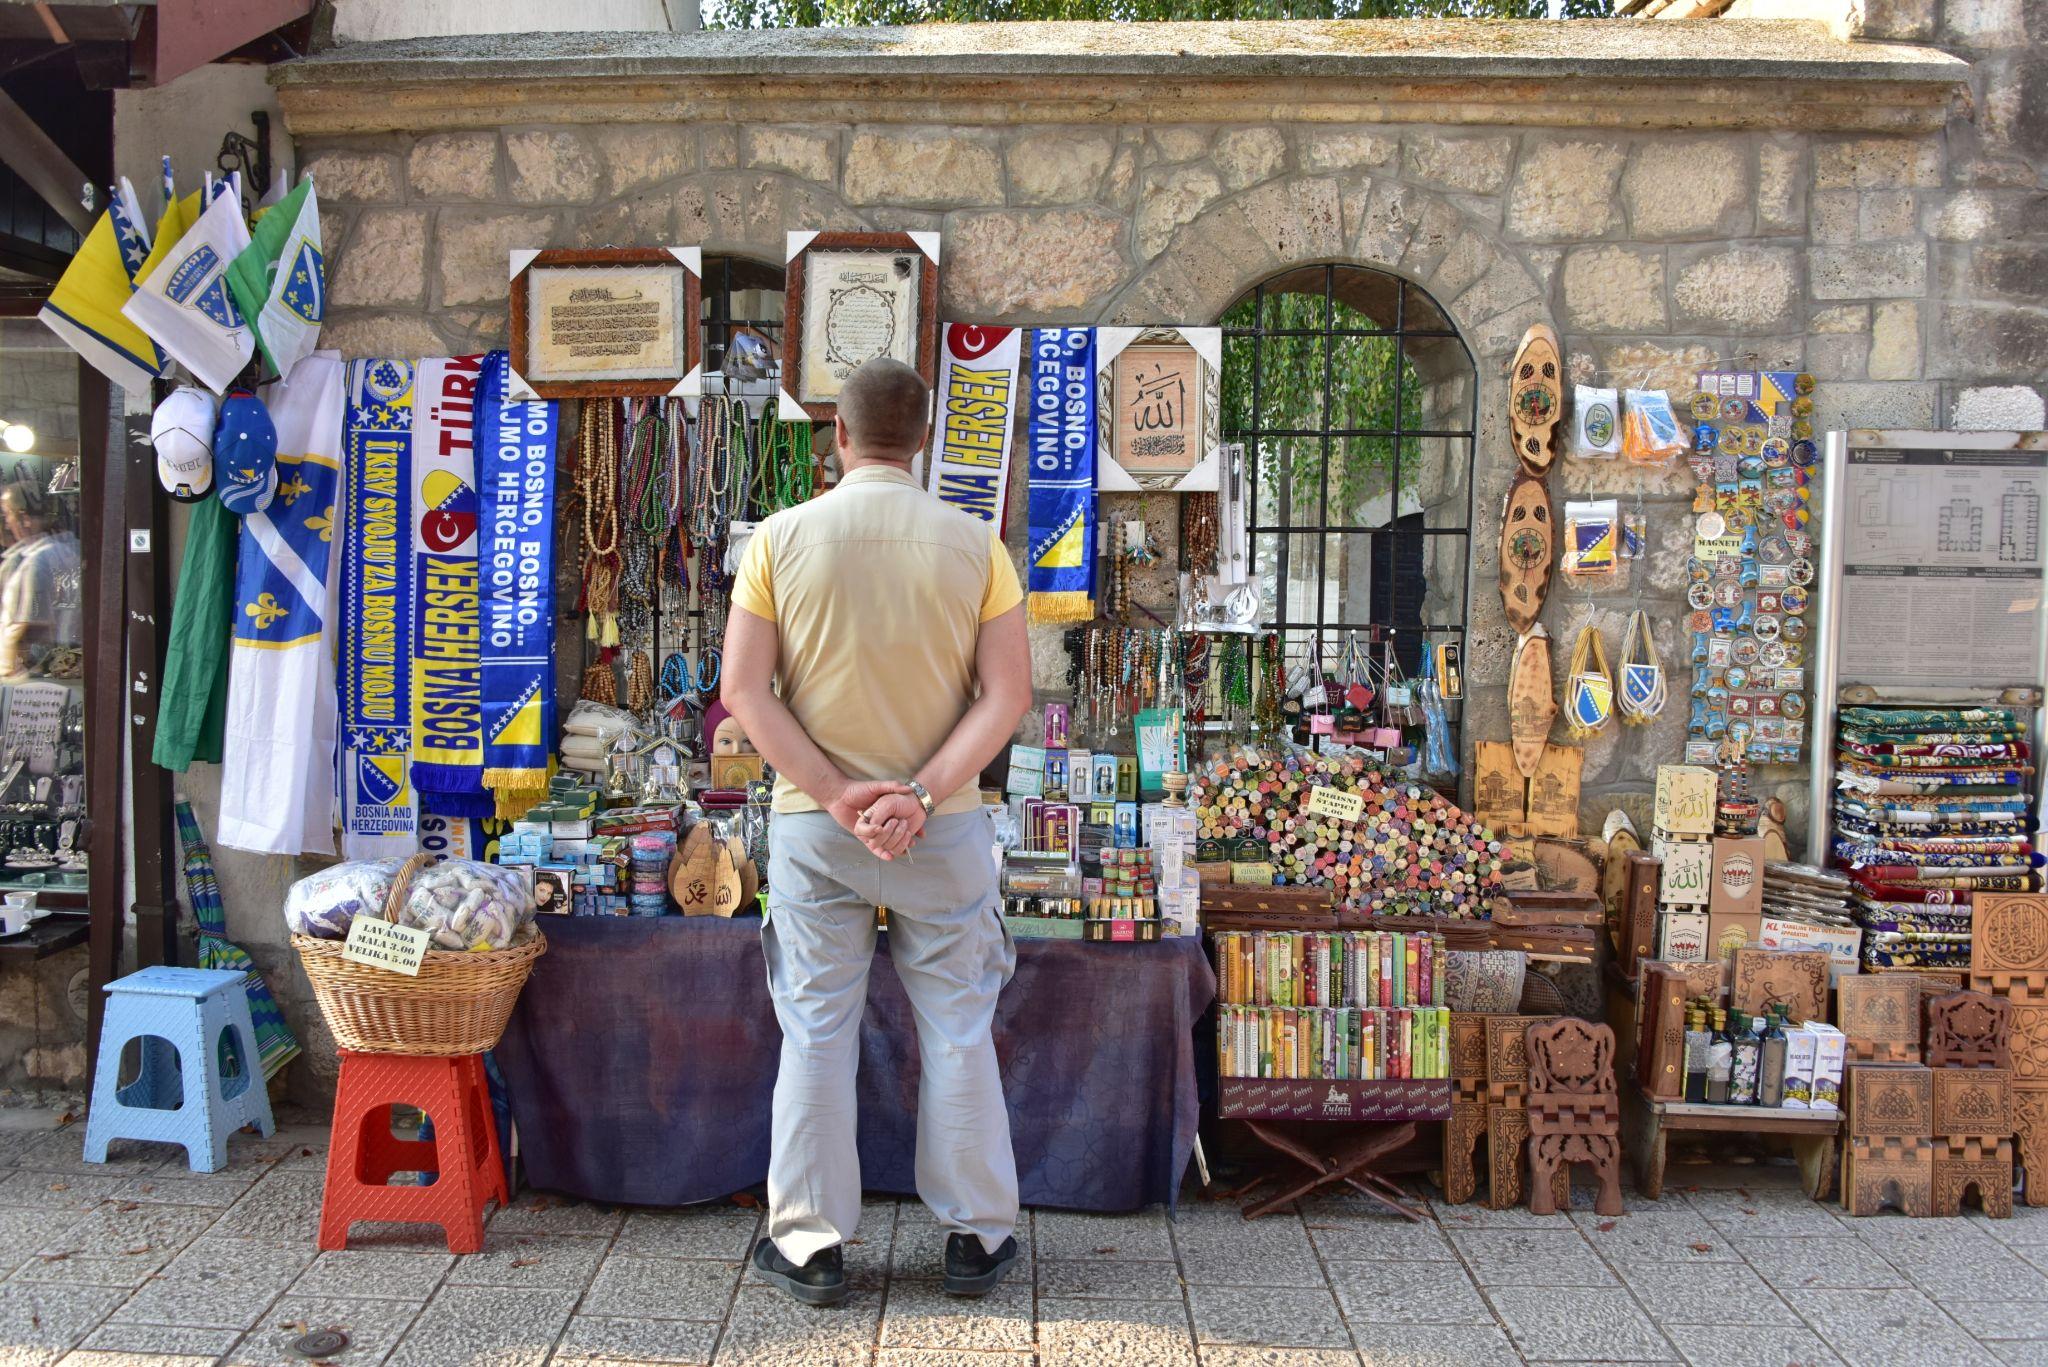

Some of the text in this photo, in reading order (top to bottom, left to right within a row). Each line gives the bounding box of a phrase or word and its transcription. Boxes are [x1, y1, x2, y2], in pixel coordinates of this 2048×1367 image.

[942, 364, 1011, 469] HERSEK
[1065, 365, 1086, 470] BOSNO...
[363, 453, 398, 498] KRV
[519, 445, 546, 533] BOSNO,
[362, 498, 398, 563] SVOJU
[1698, 539, 1740, 548] MAGNETI
[361, 564, 397, 594] ZA
[492, 472, 519, 648] HERCEGOVINO
[517, 541, 540, 647] BOSNO...
[361, 595, 396, 664] BOSNU
[422, 557, 481, 750] BOSNA HERSEK
[361, 664, 396, 722] MOJU
[352, 819, 414, 832] HERZEGOVINA
[355, 806, 412, 819] BOSNIA AND
[356, 935, 415, 955] MALA 3.00
[363, 924, 415, 943] LAVANDA
[1765, 922, 1778, 931] KL
[348, 944, 417, 968] VELIKA 5.00
[1322, 1103, 1352, 1113] Tulasi
